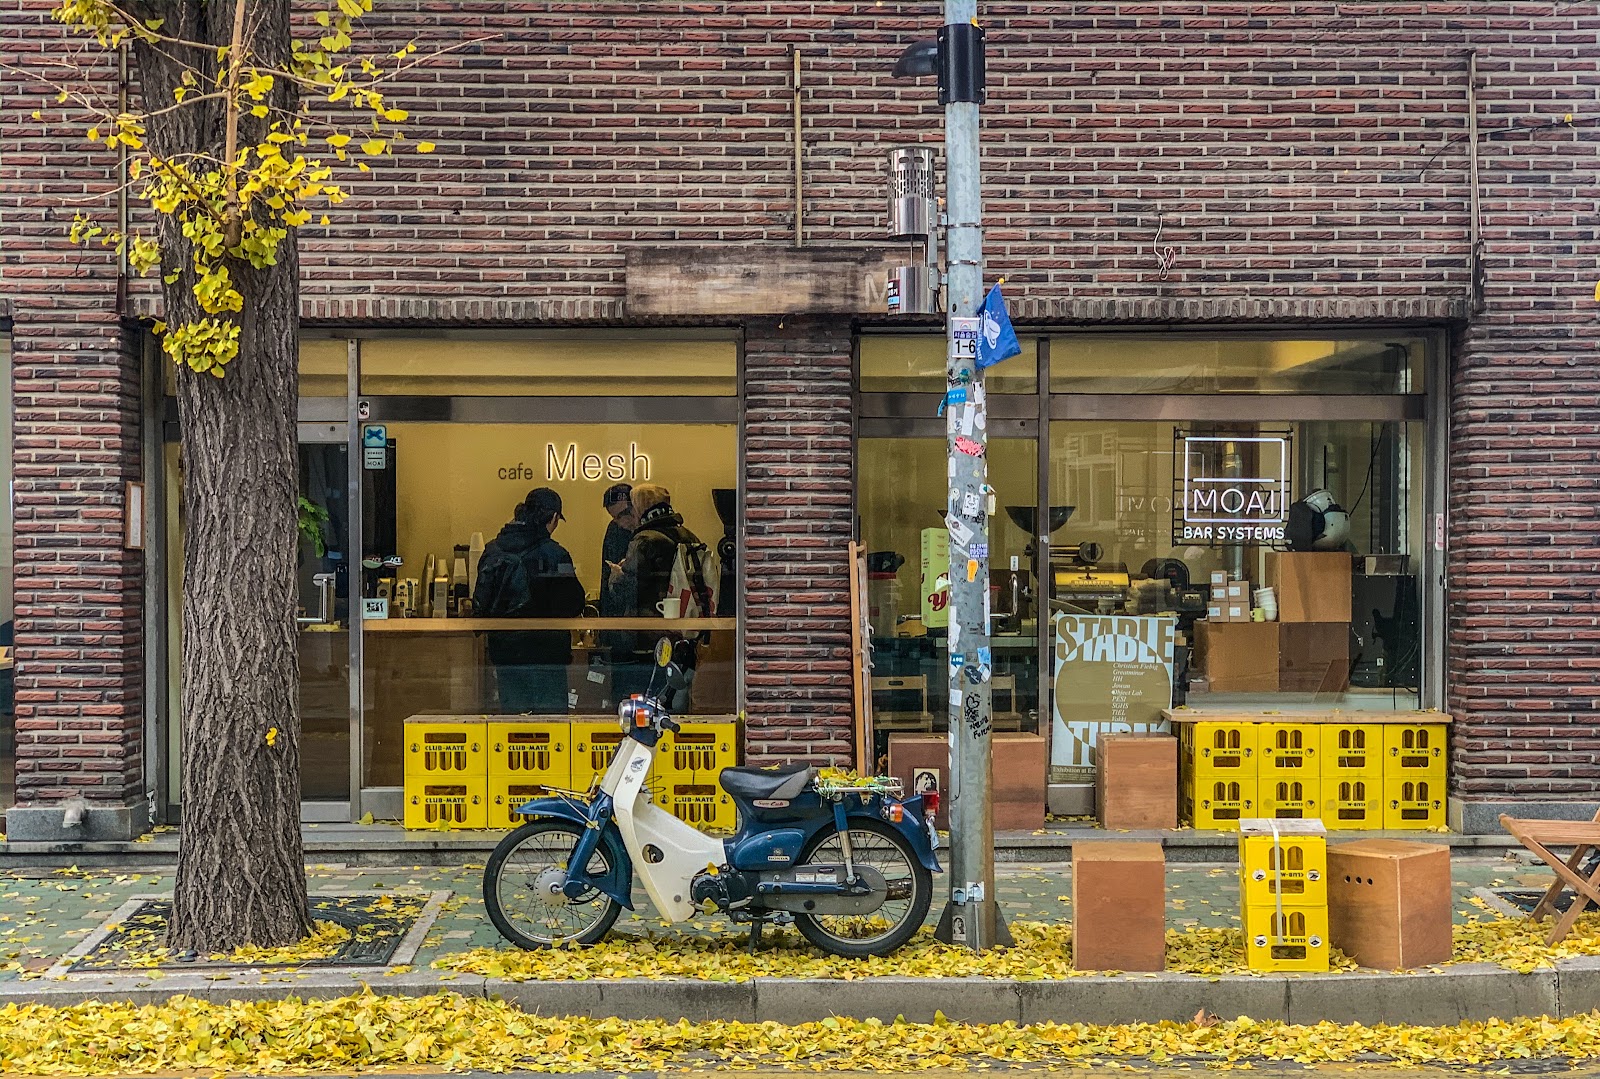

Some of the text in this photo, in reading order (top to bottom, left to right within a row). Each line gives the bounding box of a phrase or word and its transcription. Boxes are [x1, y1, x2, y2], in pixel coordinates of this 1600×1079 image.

[955, 339, 976, 354] 1-6
[498, 441, 651, 481] cafe Mesh
[1193, 488, 1275, 515] MOAI
[1183, 526, 1213, 540] BAR
[1216, 526, 1285, 540] SYSTEMS
[1057, 615, 1174, 663] STABLE
